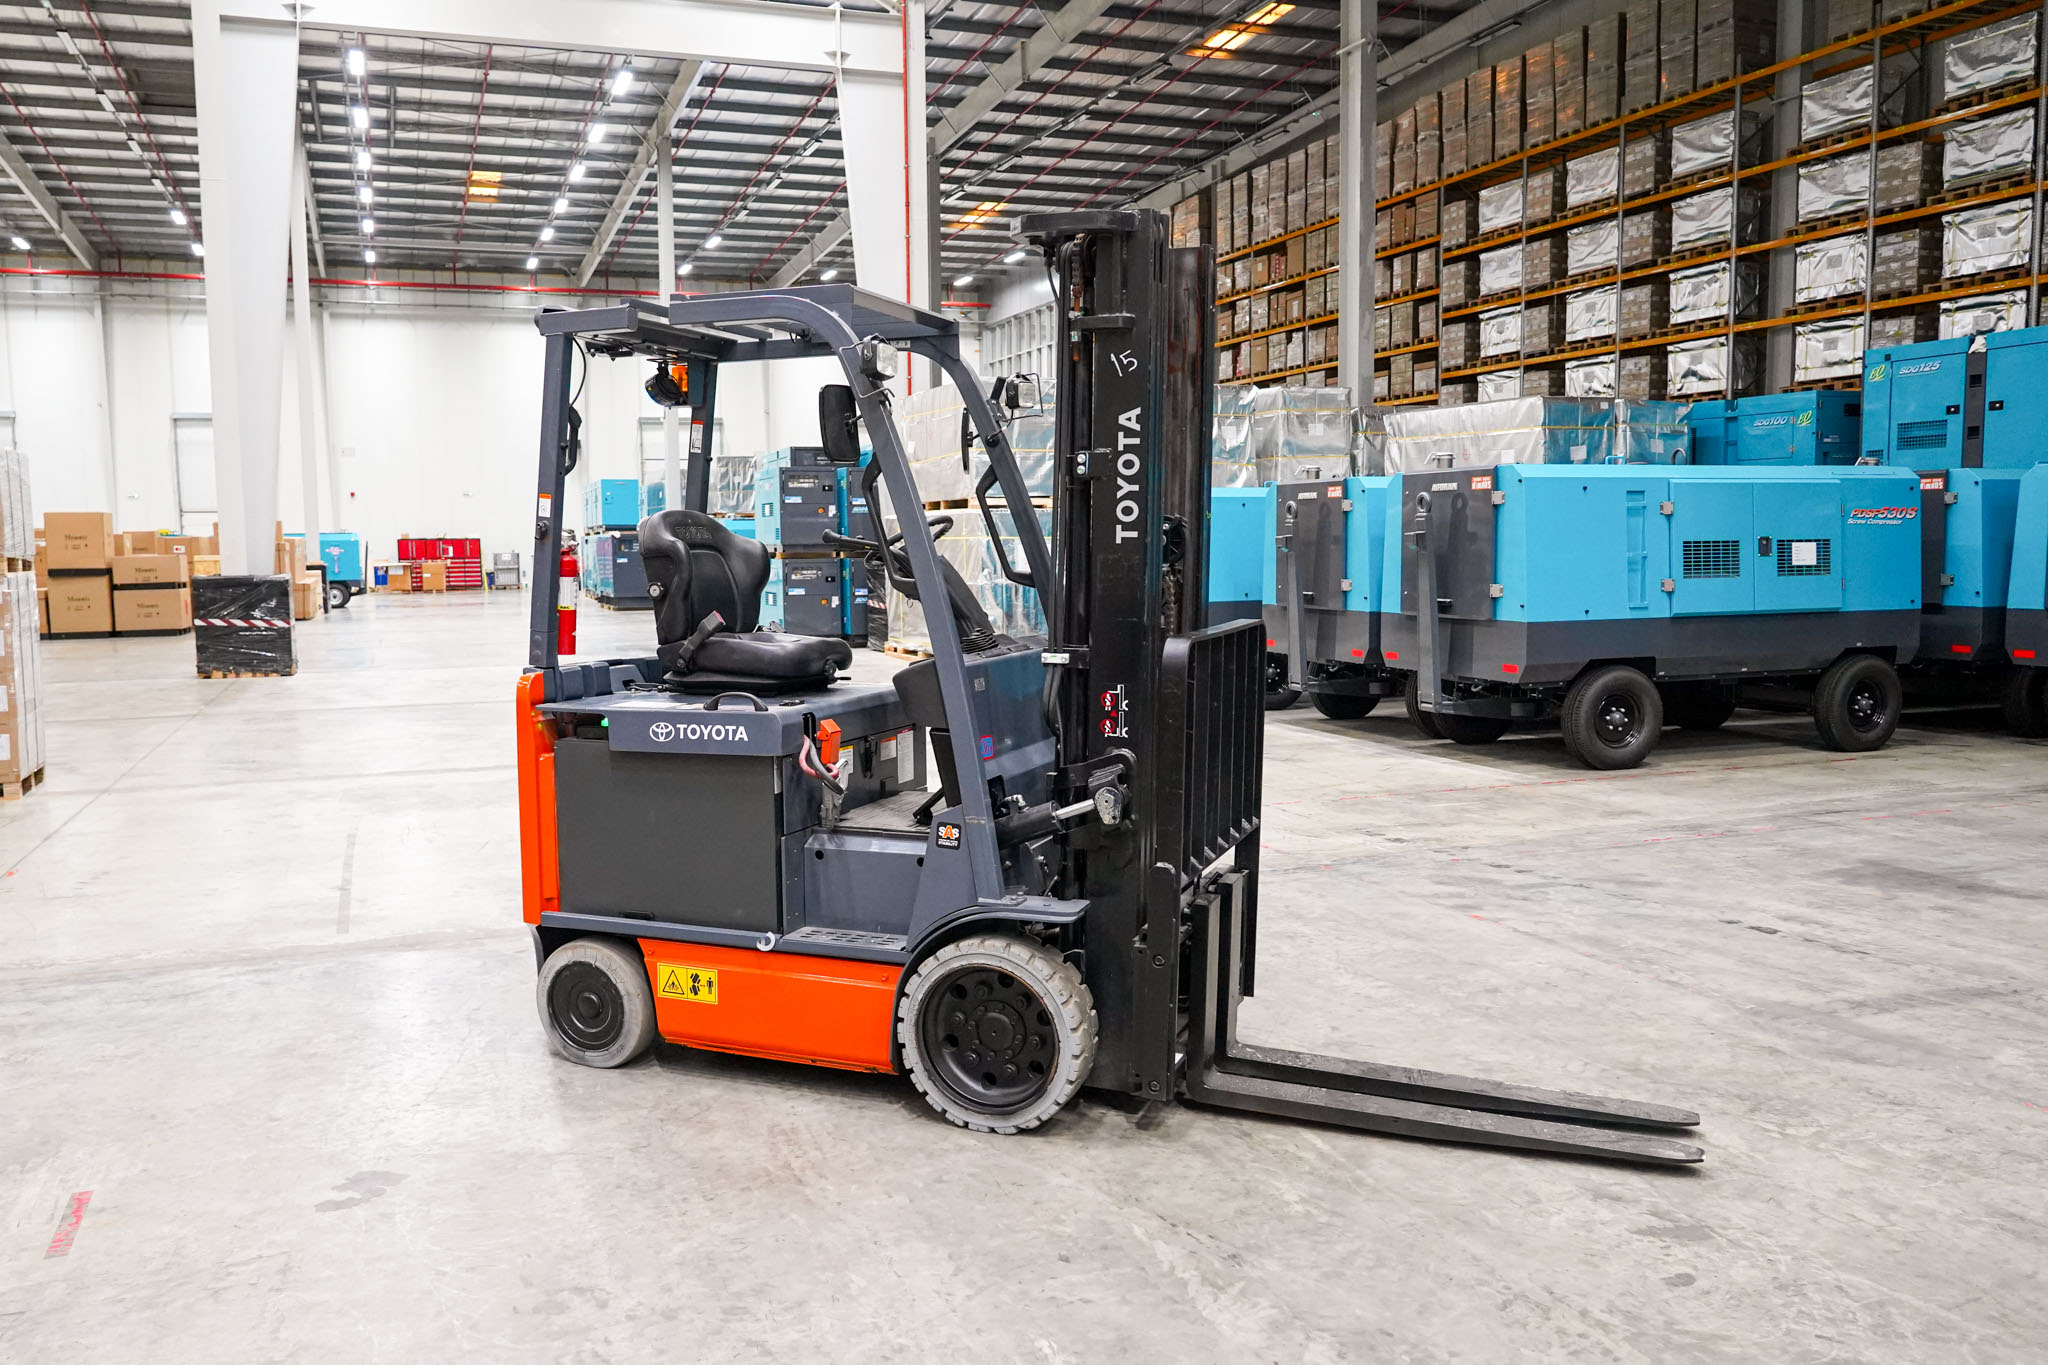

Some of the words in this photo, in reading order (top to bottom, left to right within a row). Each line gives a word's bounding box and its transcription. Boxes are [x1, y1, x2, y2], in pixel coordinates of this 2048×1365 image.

[1110, 350, 1138, 377] 15
[1900, 361, 1943, 375] SDG125
[1115, 406, 1142, 545] TOYOTA
[1431, 482, 1458, 492] AIRMAN
[1850, 506, 1919, 519] PDSF530S
[1867, 518, 1903, 526] Compressor
[676, 723, 749, 742] TOYOTA
[938, 825, 960, 840] SAS
